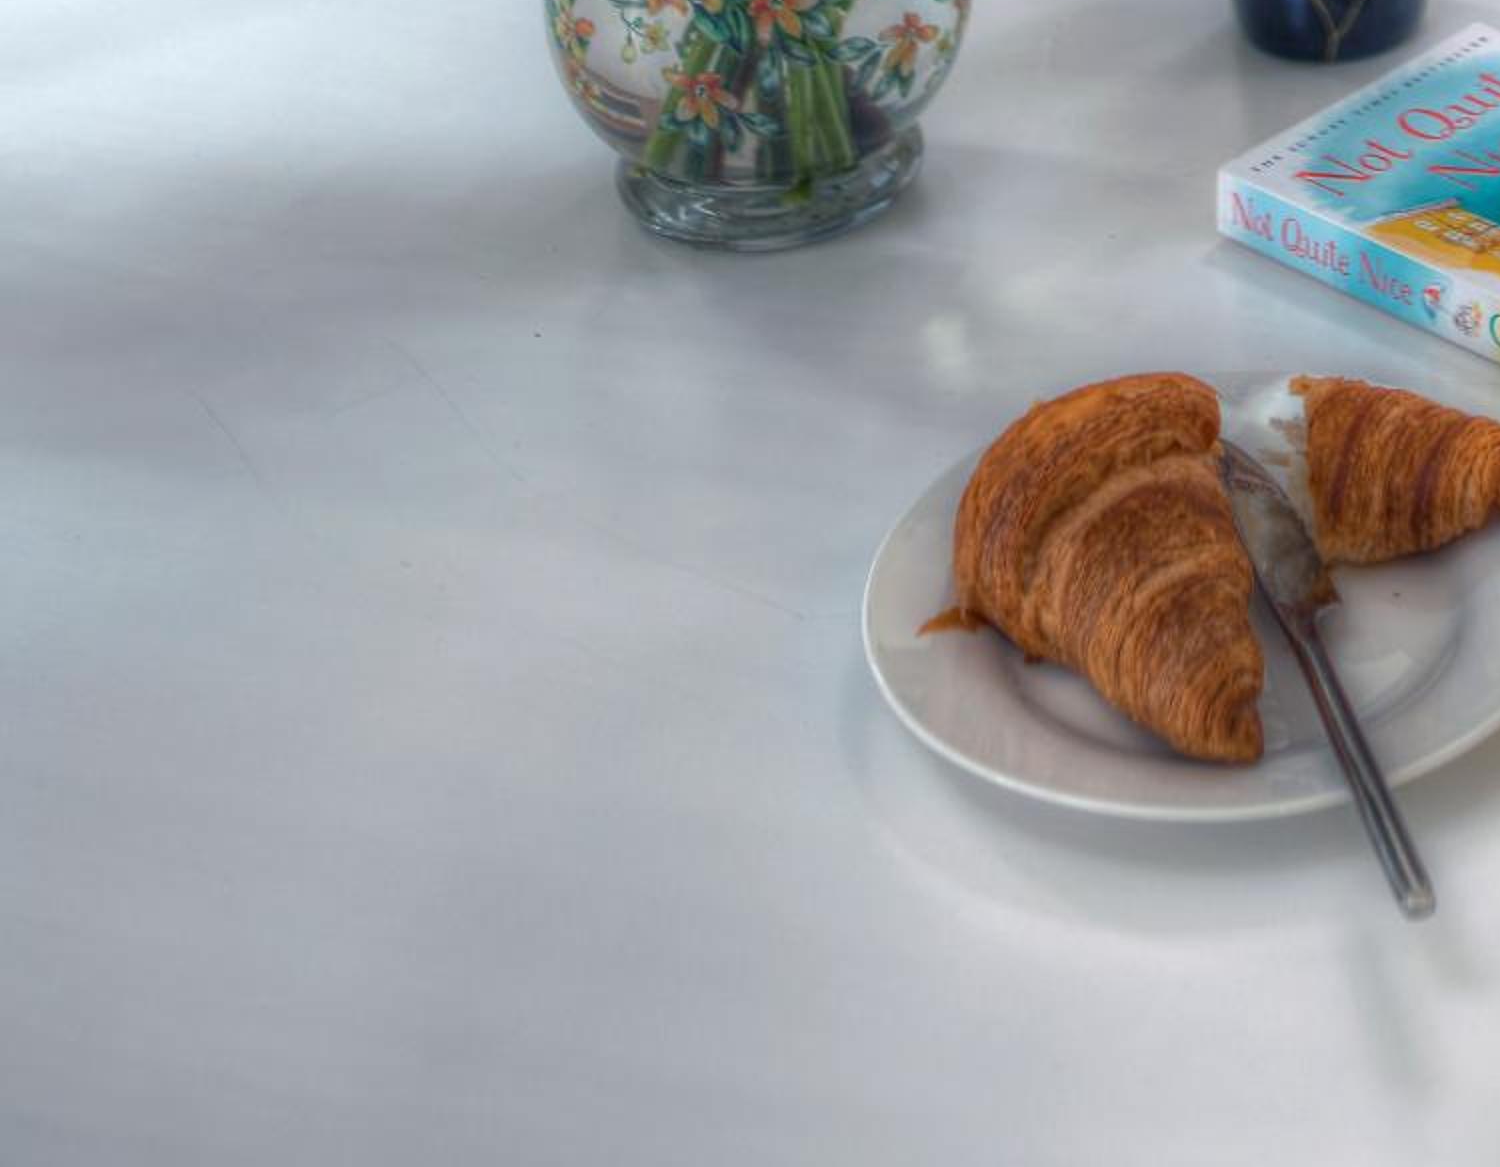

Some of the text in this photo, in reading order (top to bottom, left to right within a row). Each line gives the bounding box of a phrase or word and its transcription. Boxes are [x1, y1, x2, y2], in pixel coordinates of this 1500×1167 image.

[1294, 139, 1414, 197] Not
[1231, 191, 1413, 306] Not Quite Nice
